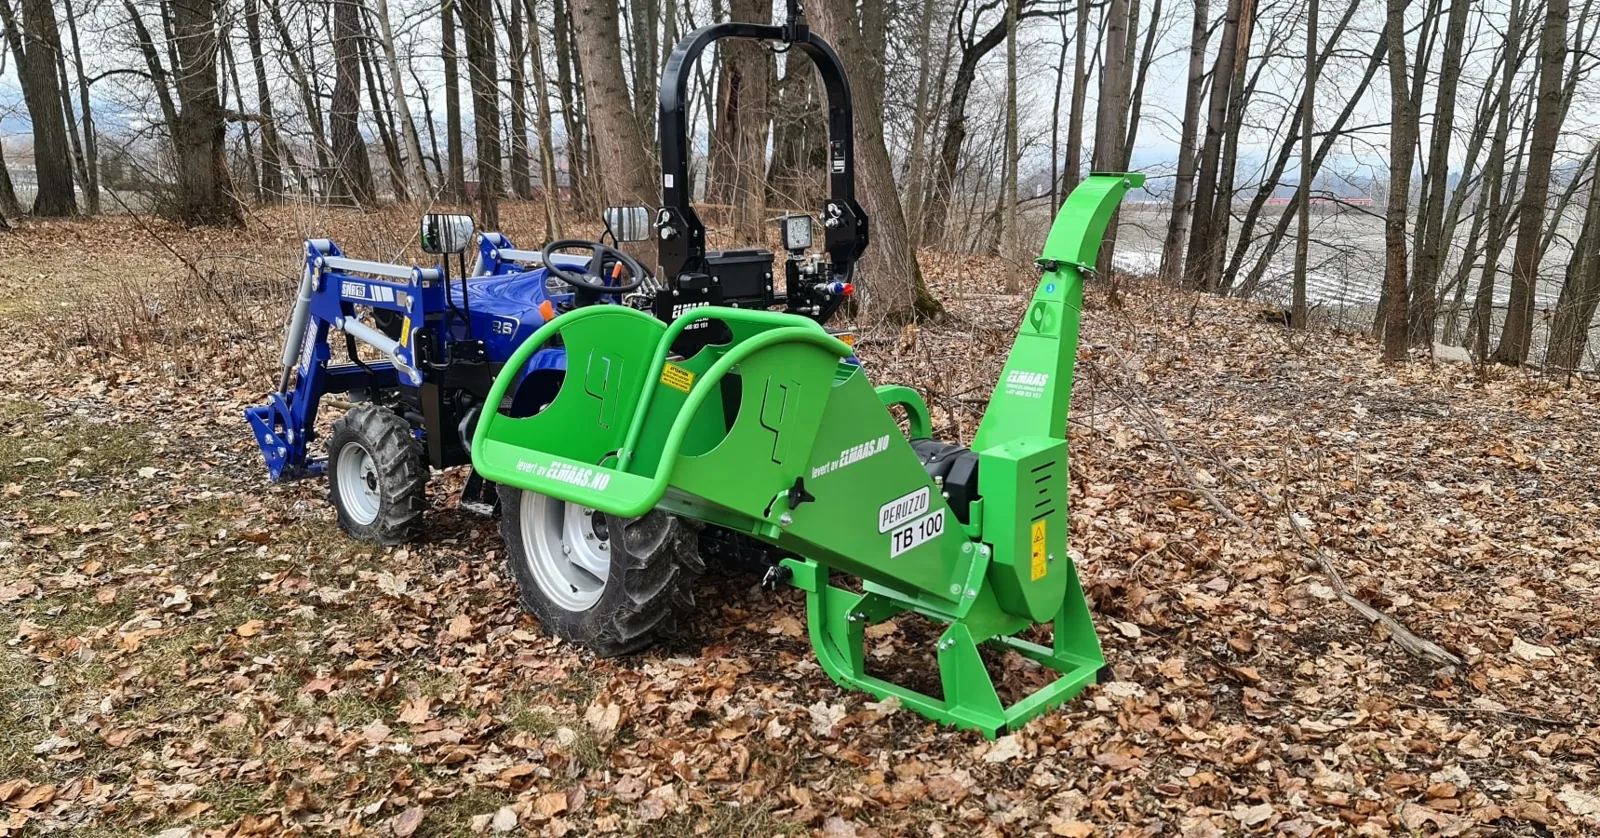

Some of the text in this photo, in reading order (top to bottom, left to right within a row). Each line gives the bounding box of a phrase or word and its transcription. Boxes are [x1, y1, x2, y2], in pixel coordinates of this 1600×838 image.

[492, 320, 513, 335] 26
[1006, 370, 1049, 386] ELMAAS
[812, 434, 889, 479] levert av ELMAAS.NO
[516, 458, 611, 491] levert av ELMAAS.NO
[882, 492, 926, 527] PERUZZO
[893, 513, 943, 553] TB 100
